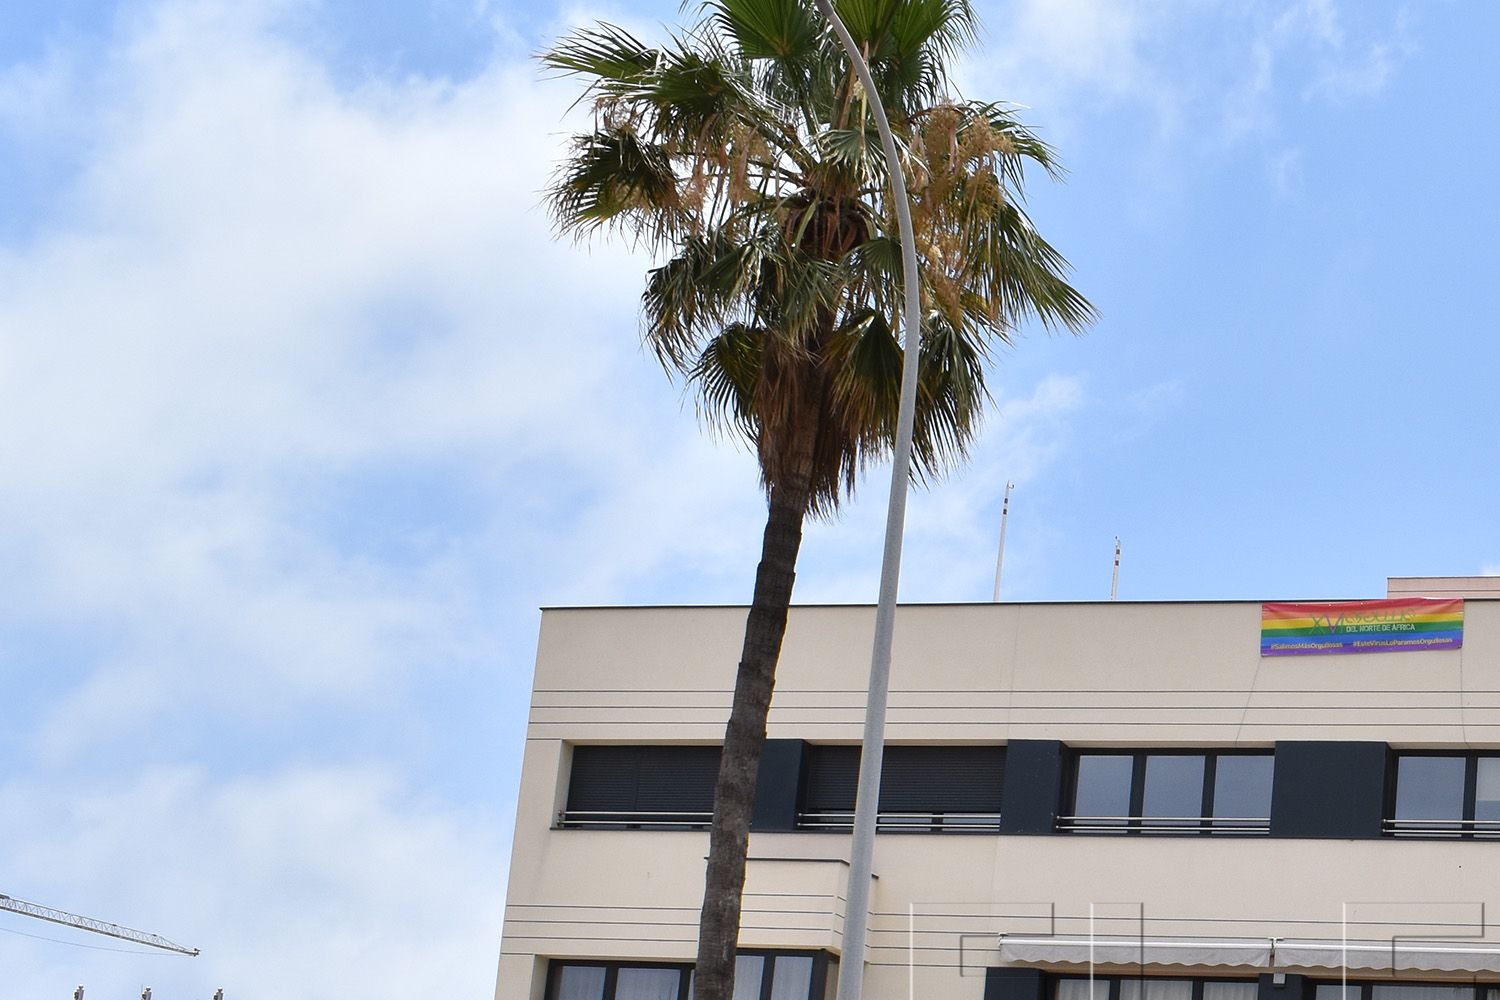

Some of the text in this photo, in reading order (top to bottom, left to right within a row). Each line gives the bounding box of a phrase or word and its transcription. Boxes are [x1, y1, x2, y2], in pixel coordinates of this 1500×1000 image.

[1345, 625, 1358, 633] DEL
[1359, 624, 1381, 633] NORTE
[1382, 623, 1391, 632] DE
